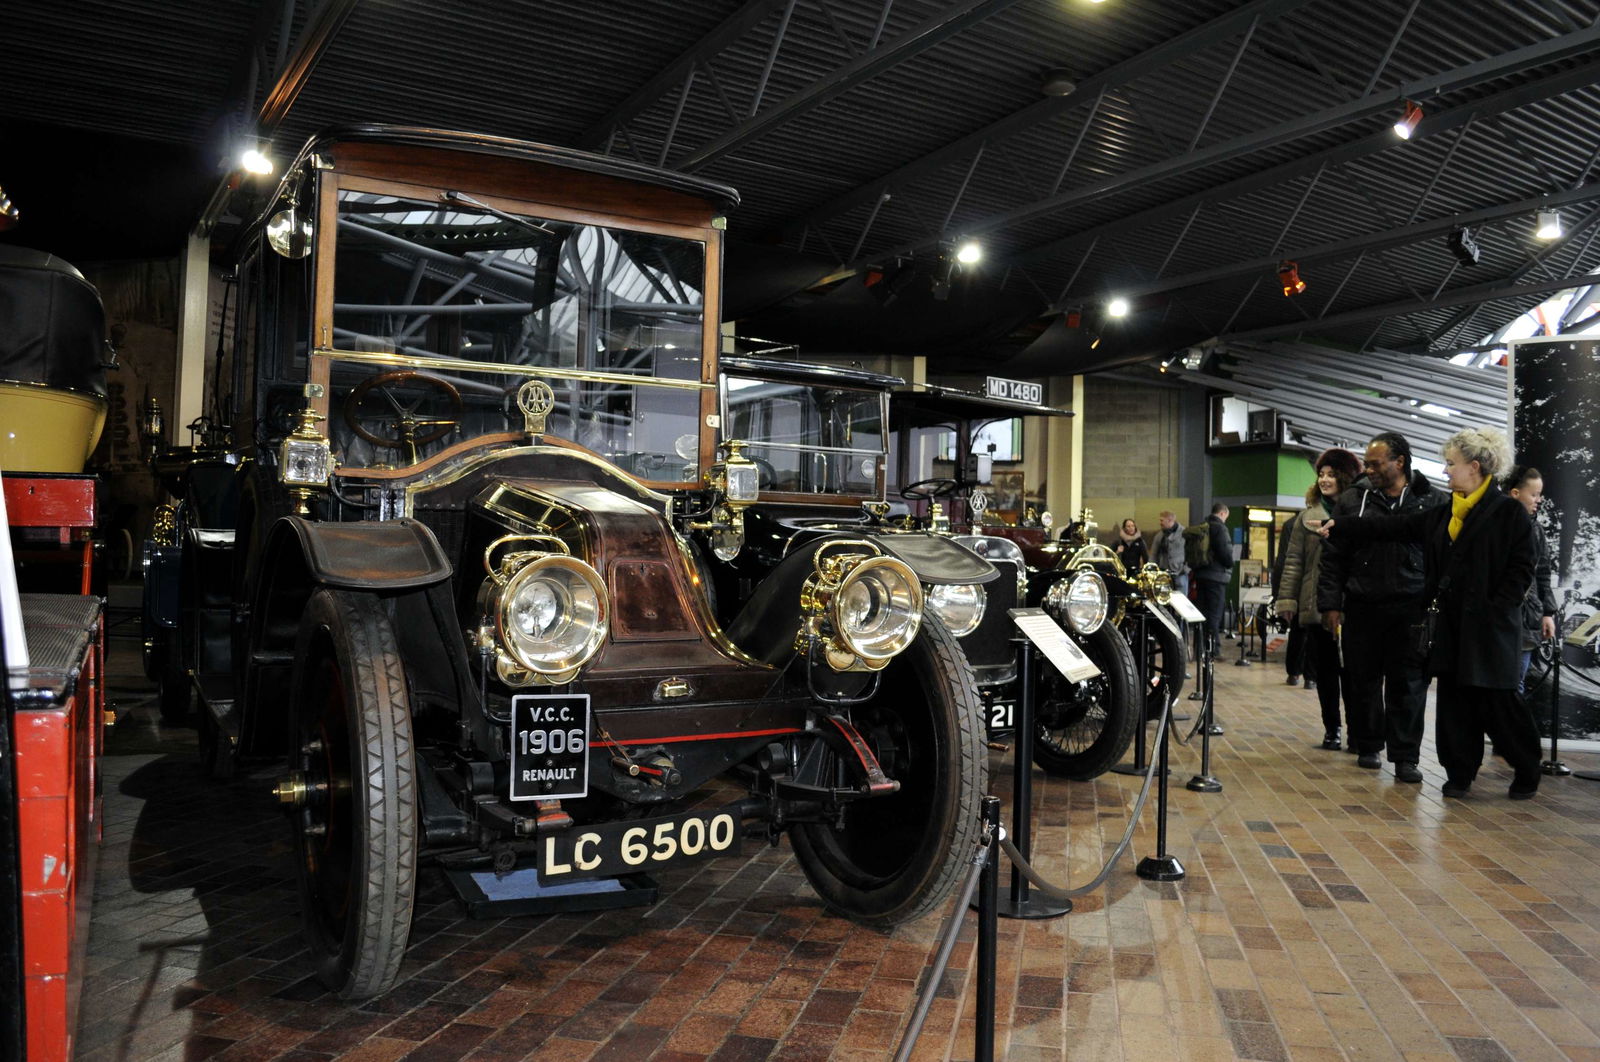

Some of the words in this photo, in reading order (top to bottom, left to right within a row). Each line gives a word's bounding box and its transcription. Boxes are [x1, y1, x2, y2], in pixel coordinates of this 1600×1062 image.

[989, 379, 1007, 397] MD
[1009, 382, 1038, 402] 1480
[530, 707, 575, 723] V.C.C.
[519, 728, 584, 756] 1906
[522, 767, 577, 782] RENAULT
[545, 832, 603, 876] LC
[620, 813, 735, 866] 6500
